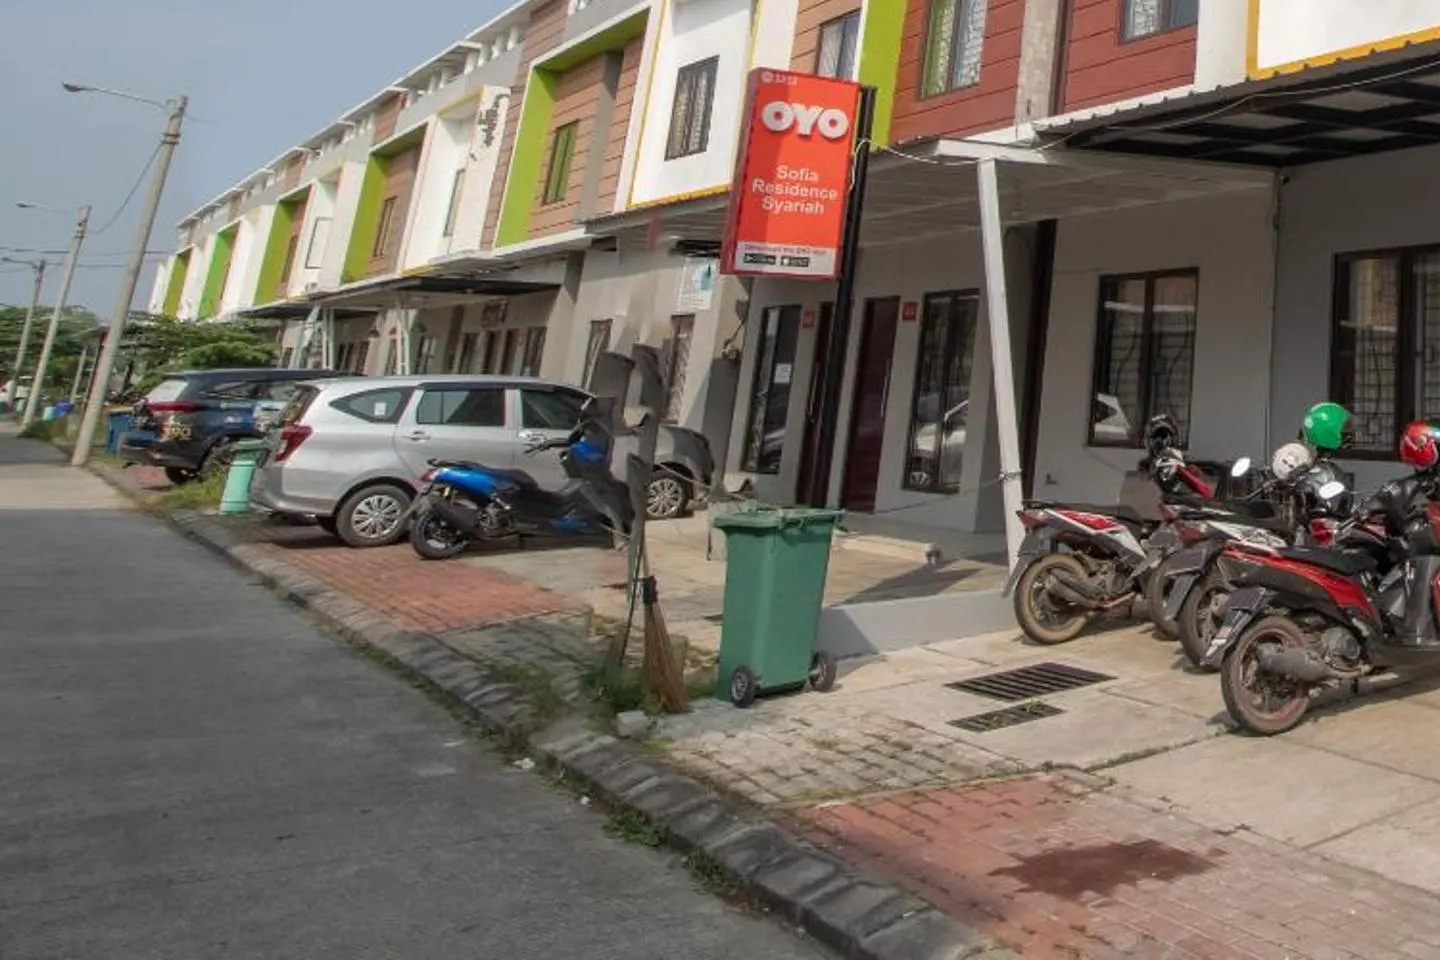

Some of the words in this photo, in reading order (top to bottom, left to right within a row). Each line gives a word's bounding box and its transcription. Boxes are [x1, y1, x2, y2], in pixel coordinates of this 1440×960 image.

[762, 101, 849, 139] OYO
[776, 164, 819, 182] Sofia
[752, 178, 838, 200] Residence
[762, 196, 824, 215] Syariah
